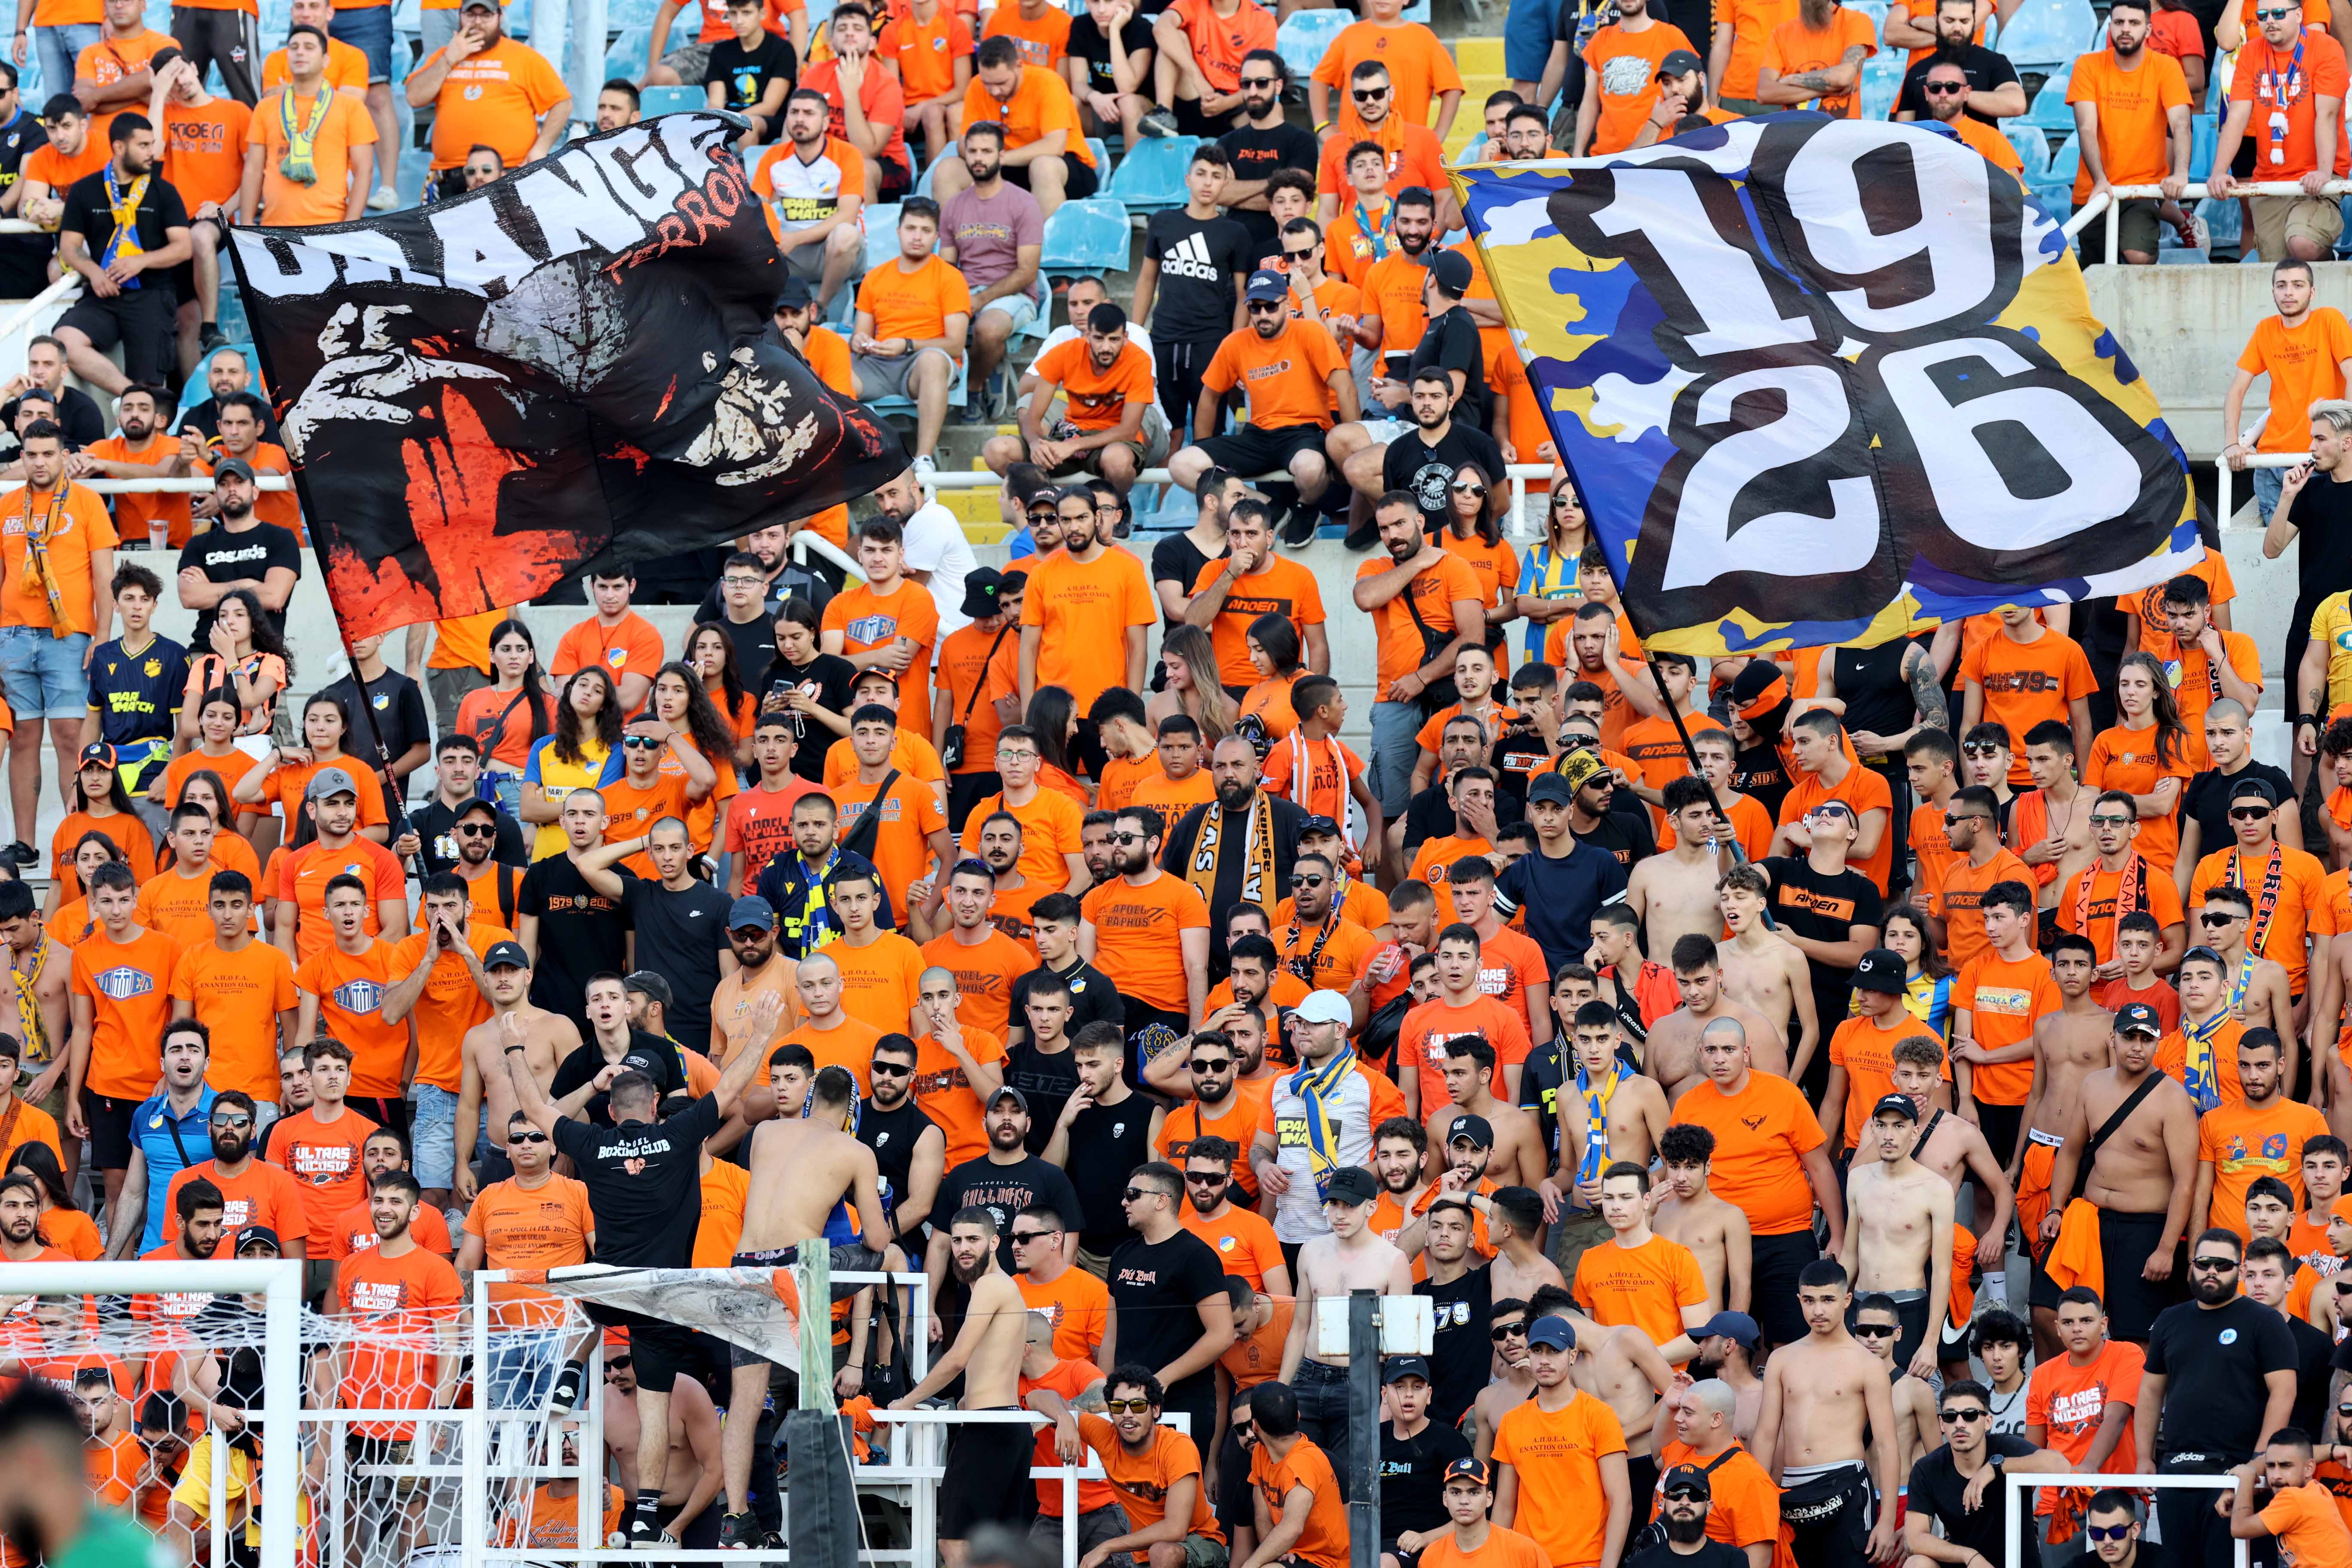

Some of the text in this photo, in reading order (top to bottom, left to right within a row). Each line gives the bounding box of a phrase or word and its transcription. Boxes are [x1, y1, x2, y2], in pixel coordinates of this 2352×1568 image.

[1257, 150, 1278, 160] Bull
[1589, 119, 1996, 357] 19
[1161, 259, 1218, 282] adidas
[1662, 338, 2142, 592] 26
[2015, 670, 2047, 693] 79
[113, 701, 155, 714] MATCH
[2135, 754, 2156, 764] 2019
[1752, 772, 1778, 785] SIDE
[1262, 800, 1271, 873] against
[548, 897, 573, 910] 1979
[1112, 904, 1146, 914] APOEL
[1107, 916, 1149, 928] PAPHOS
[428, 978, 463, 987] ΕΝΑΝΤΙΟΝ
[1846, 1057, 1880, 1066] ΕΝΑΝΤΙΟΝ
[618, 1137, 649, 1146] APOEL
[2032, 1130, 2046, 1140] TOMMY
[295, 1147, 351, 1159] ULTRAS
[597, 1139, 671, 1159] BOXING CLUB
[295, 1160, 349, 1173] NICOSIA
[754, 1249, 785, 1261] DIM
[1117, 1268, 1156, 1285] Pit Bull
[356, 1282, 400, 1299] ULTRAS
[2055, 1387, 2101, 1411] ULTRAS
[1520, 1444, 1556, 1453] ΕΝΑΝΤΙΟΝ
[2170, 1452, 2205, 1464] adidas
[1387, 1461, 1412, 1474] Bull
